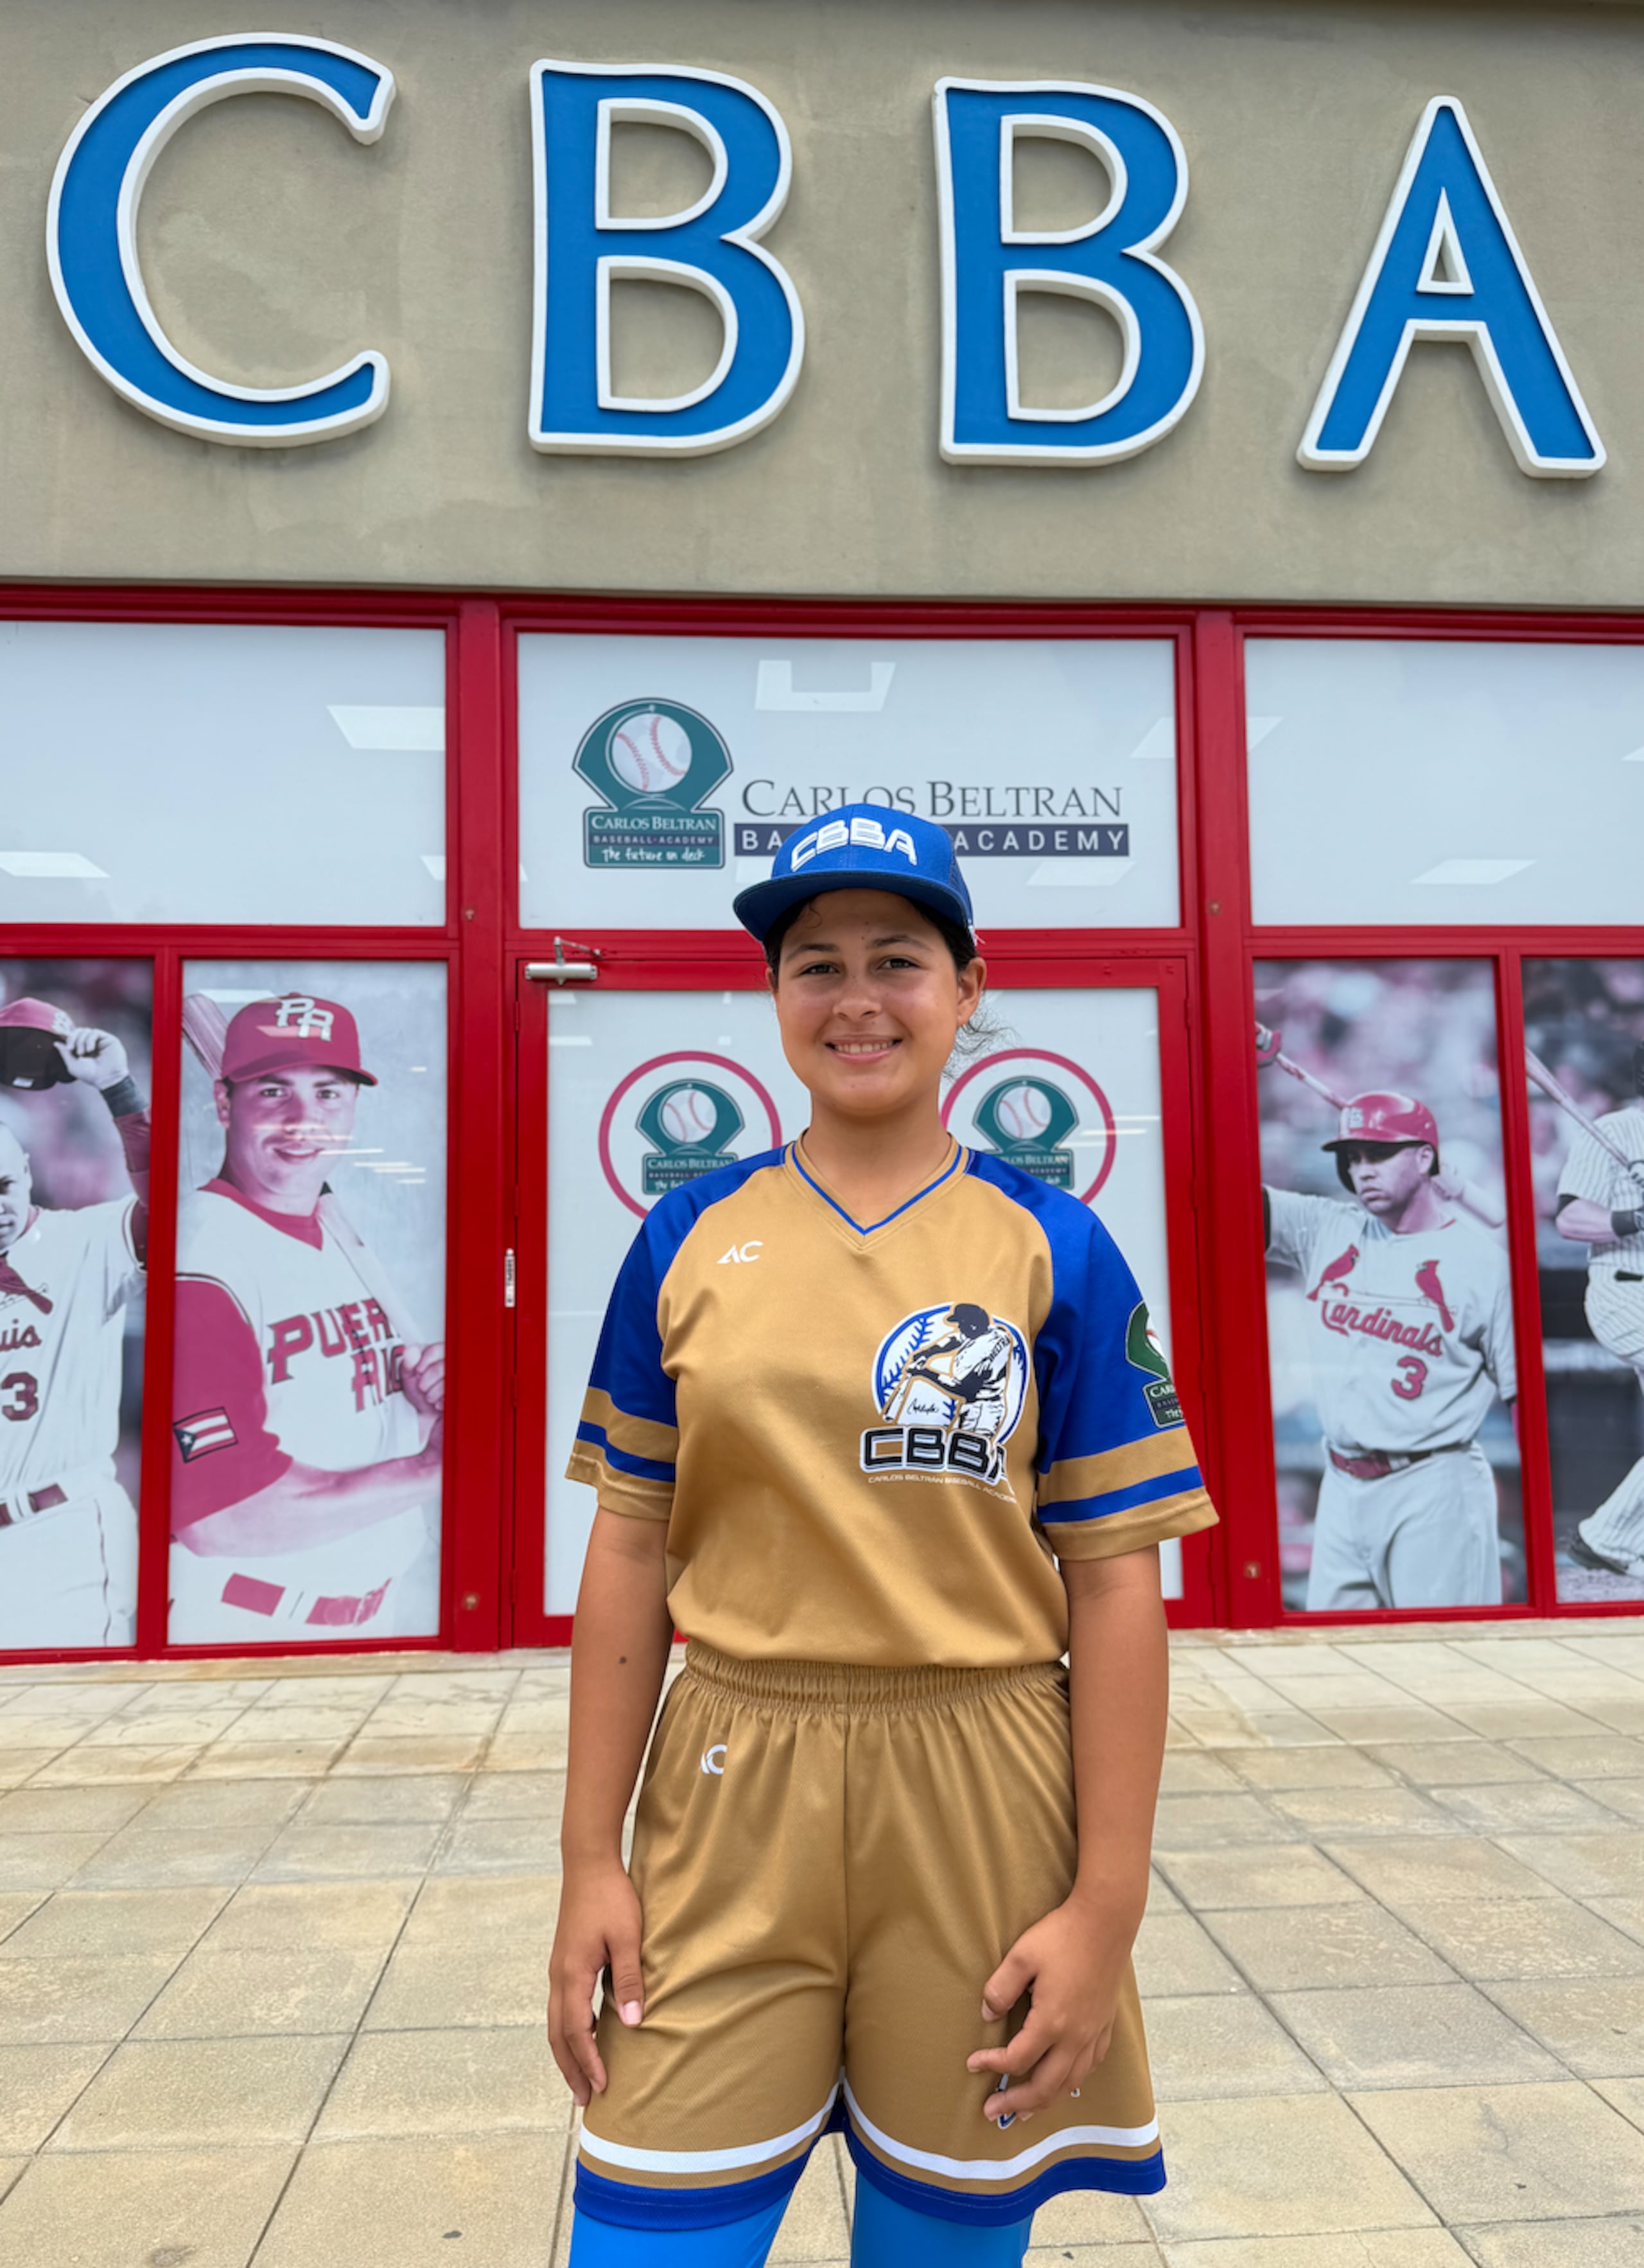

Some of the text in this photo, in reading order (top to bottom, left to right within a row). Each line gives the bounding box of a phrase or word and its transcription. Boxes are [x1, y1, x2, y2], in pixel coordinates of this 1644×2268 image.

[46, 32, 1607, 478] CBBA
[591, 815, 717, 830] CARLOS BELTRAN
[742, 779, 1123, 817] CARLOS BELTRAN
[791, 817, 918, 873] CBBA
[954, 830, 1124, 851] ACADEMY
[267, 1297, 395, 1386] PUER
[1321, 1282, 1443, 1357] Cardinals
[1, 1371, 39, 1422] 3
[351, 1345, 407, 1413] RIC
[1390, 1354, 1428, 1401] 3
